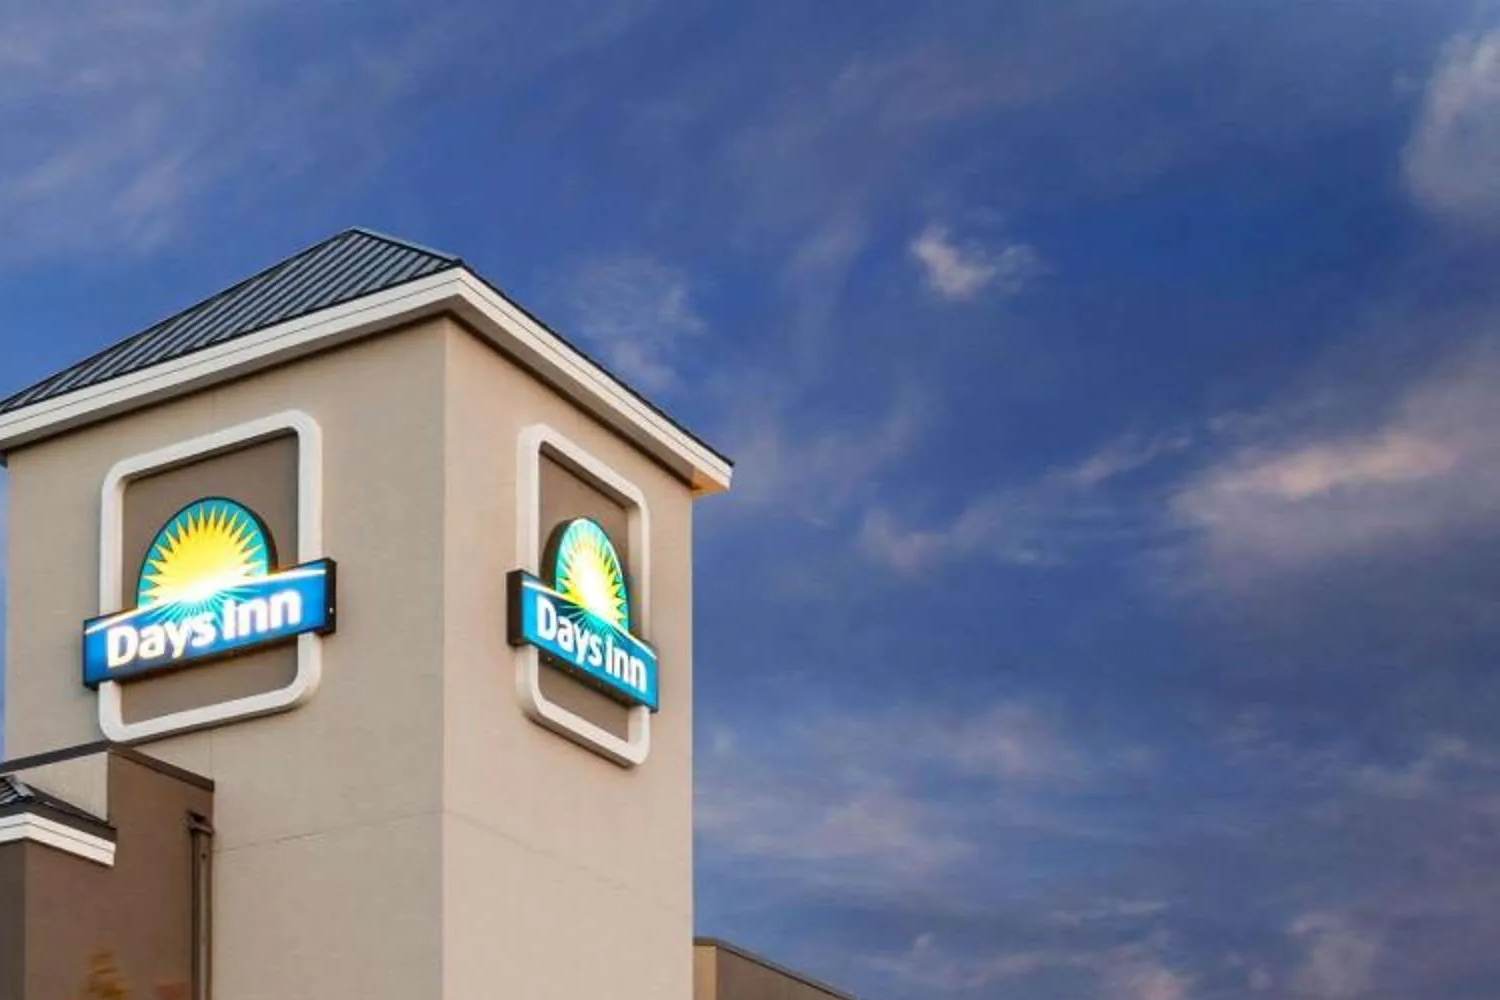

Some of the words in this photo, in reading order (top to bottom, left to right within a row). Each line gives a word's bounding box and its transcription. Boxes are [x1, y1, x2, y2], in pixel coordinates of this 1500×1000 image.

[106, 613, 217, 668] Days
[222, 589, 302, 641] Inn
[535, 595, 603, 667] Days
[606, 637, 647, 692] Inn
